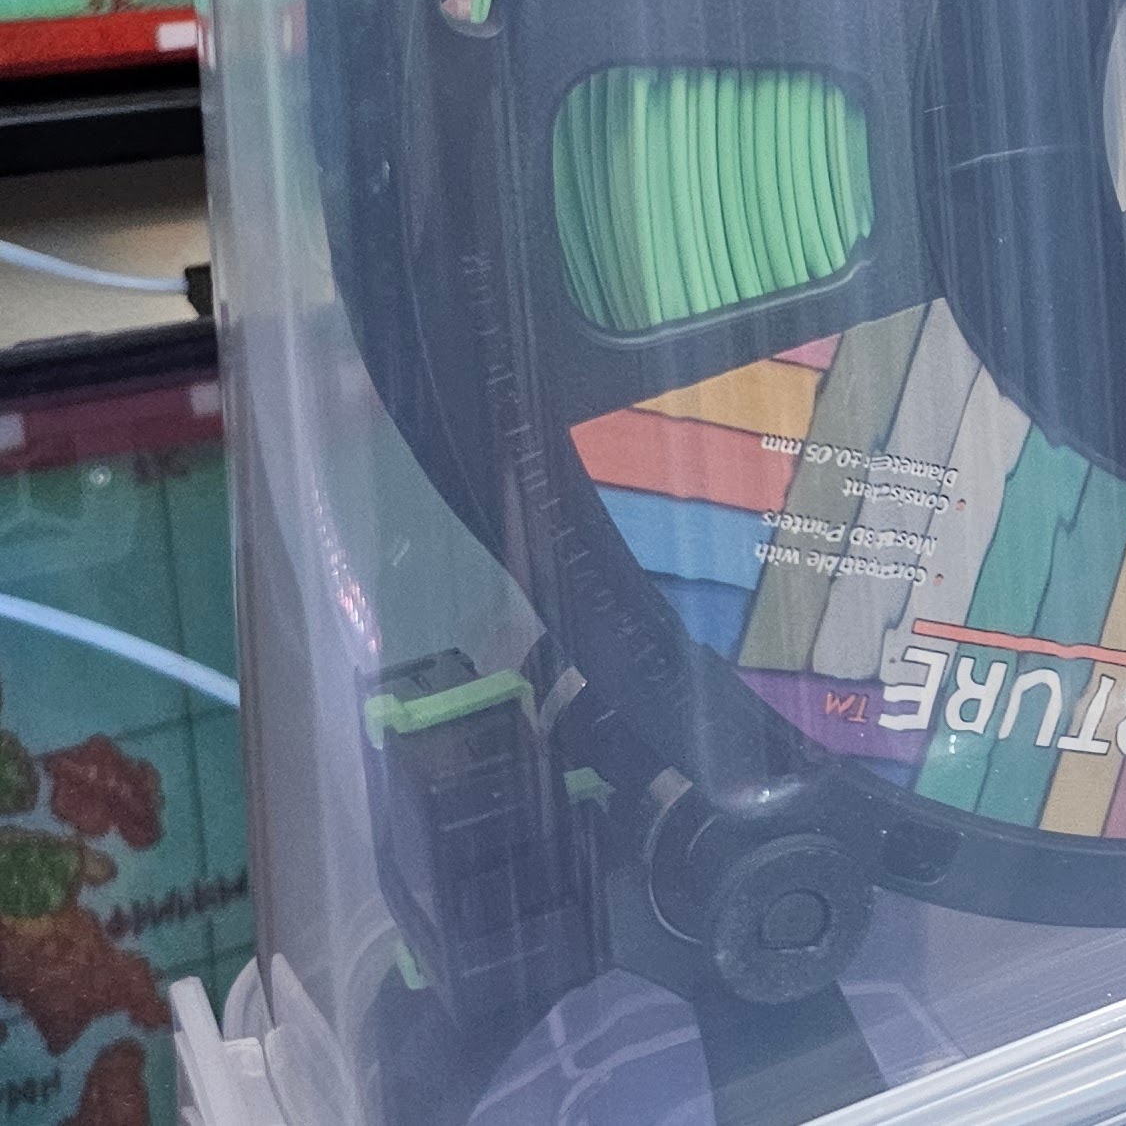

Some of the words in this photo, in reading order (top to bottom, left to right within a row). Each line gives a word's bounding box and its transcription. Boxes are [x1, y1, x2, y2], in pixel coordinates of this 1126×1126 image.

[760, 435, 802, 457] mm
[762, 511, 846, 542] Printers
[754, 542, 801, 566] with
[806, 550, 928, 586] Compatible
